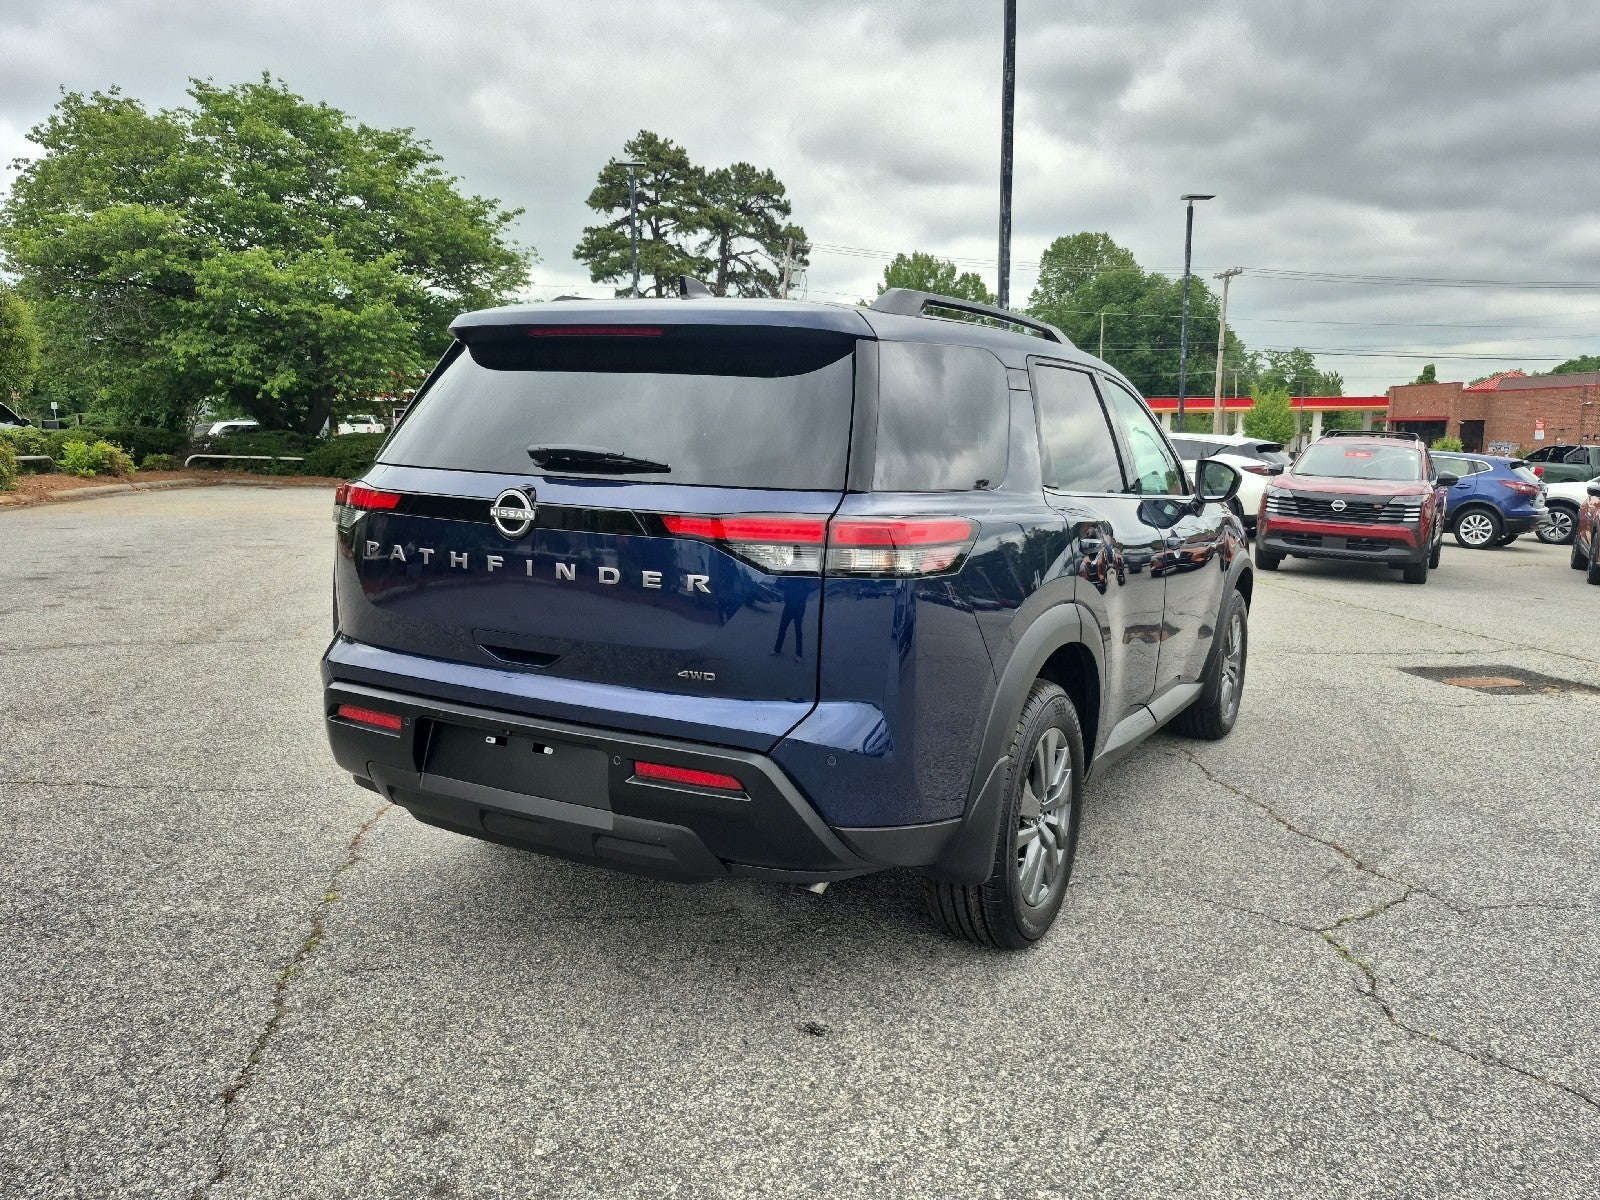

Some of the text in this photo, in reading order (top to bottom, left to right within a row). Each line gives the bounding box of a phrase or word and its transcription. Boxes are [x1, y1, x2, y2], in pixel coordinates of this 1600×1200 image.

[490, 508, 533, 519] NISSAN
[366, 540, 711, 593] PATHFINDER
[677, 670, 716, 681] 4WD
